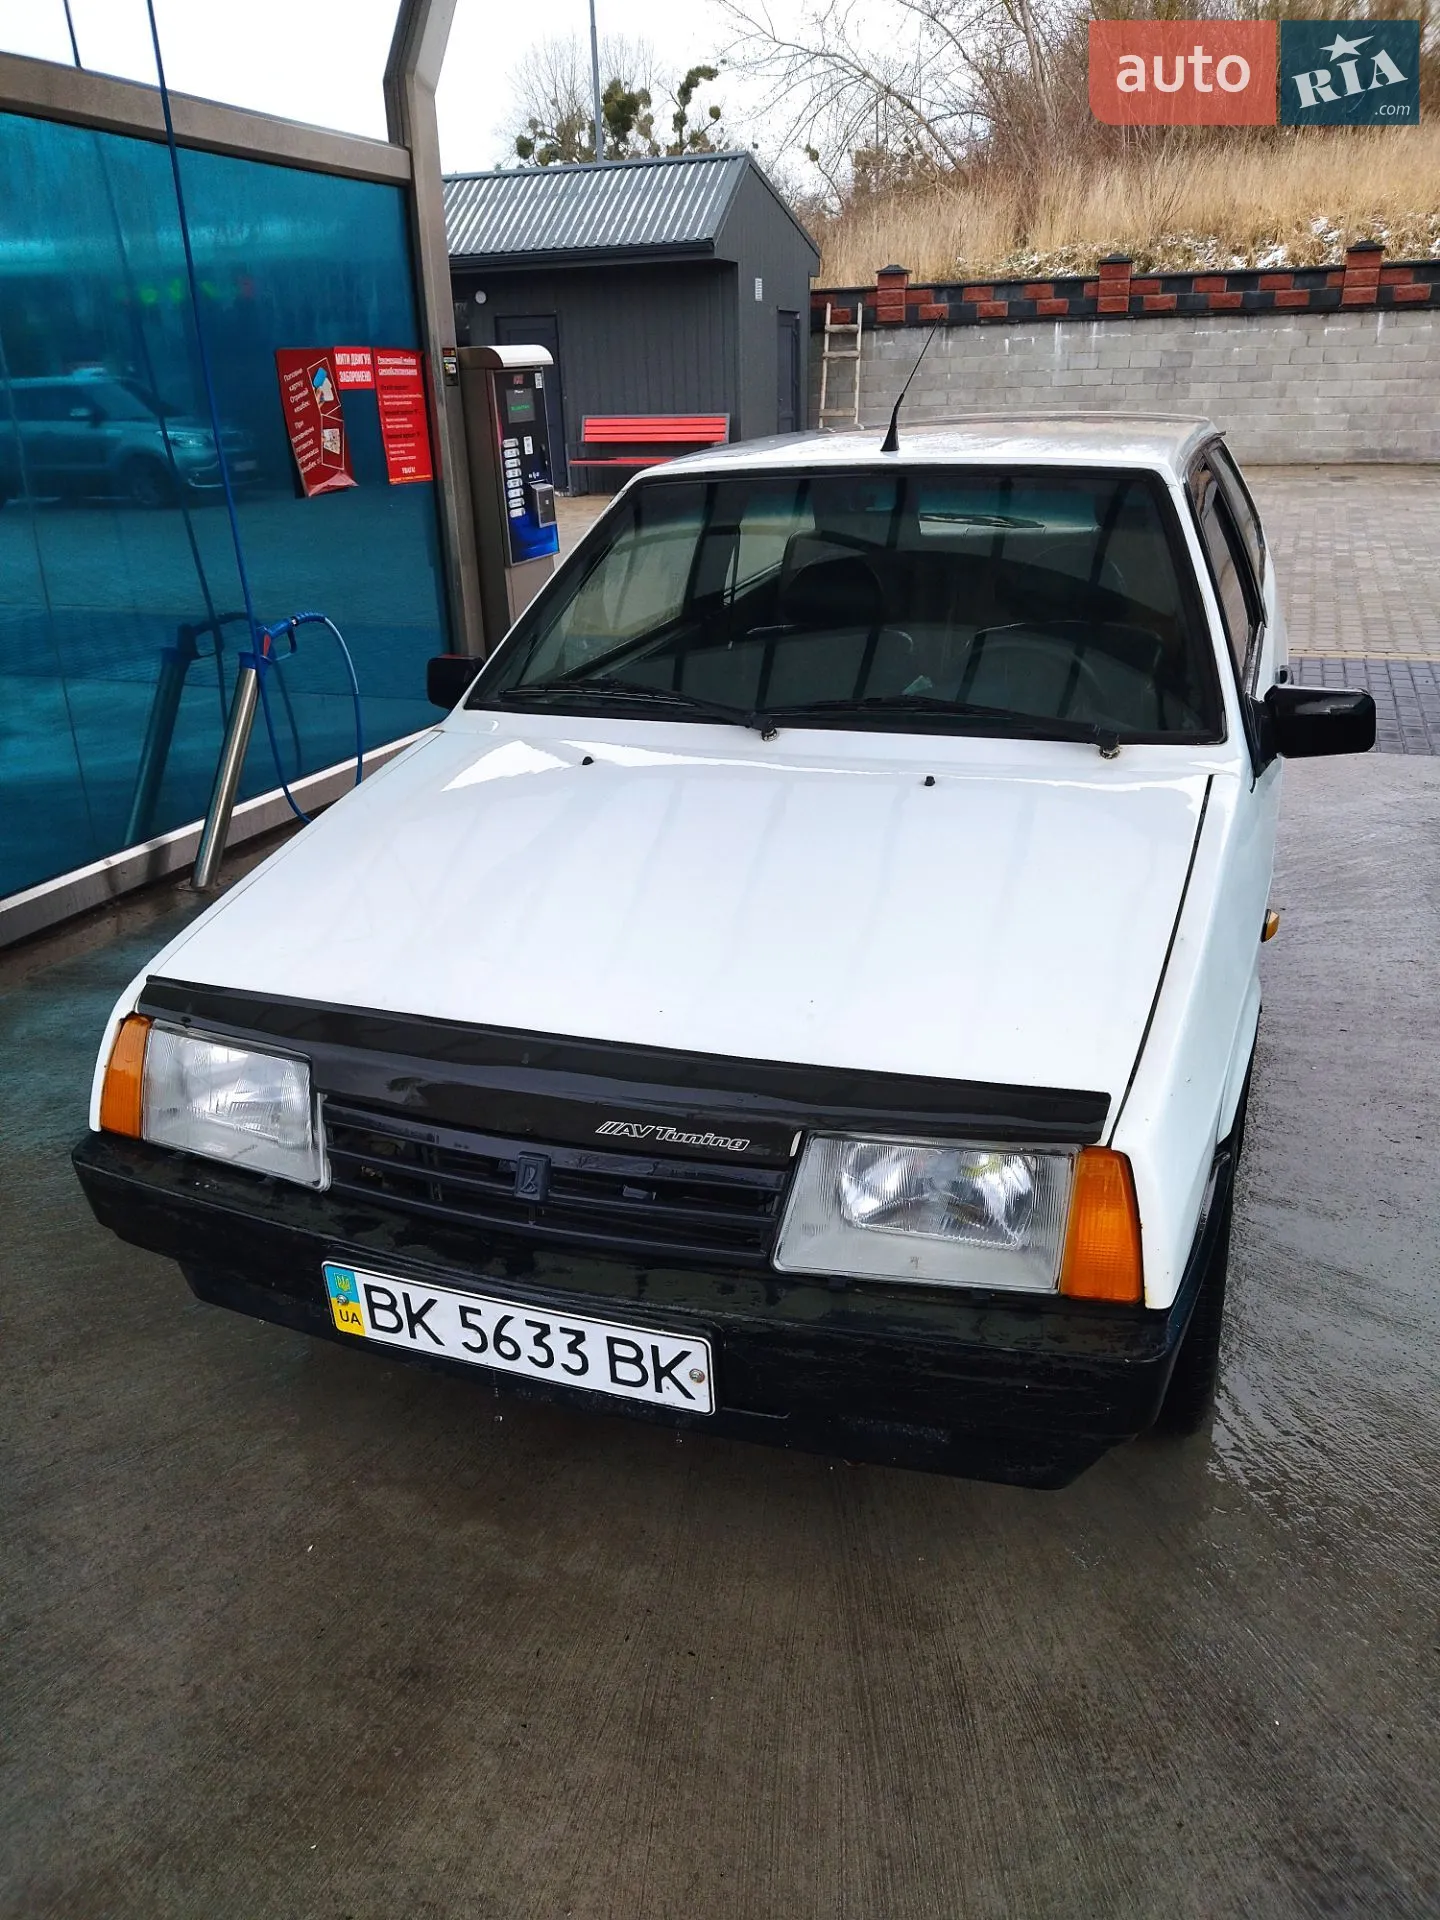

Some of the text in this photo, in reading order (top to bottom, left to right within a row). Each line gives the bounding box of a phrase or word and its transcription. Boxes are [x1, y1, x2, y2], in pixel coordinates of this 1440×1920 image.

[335, 353, 372, 367] МИТИ ДВИГУН
[339, 370, 372, 383] ЗАБОРОНЕНО
[656, 1126, 750, 1152] Tuning
[339, 1283, 697, 1401] UA BK 5633 BK
